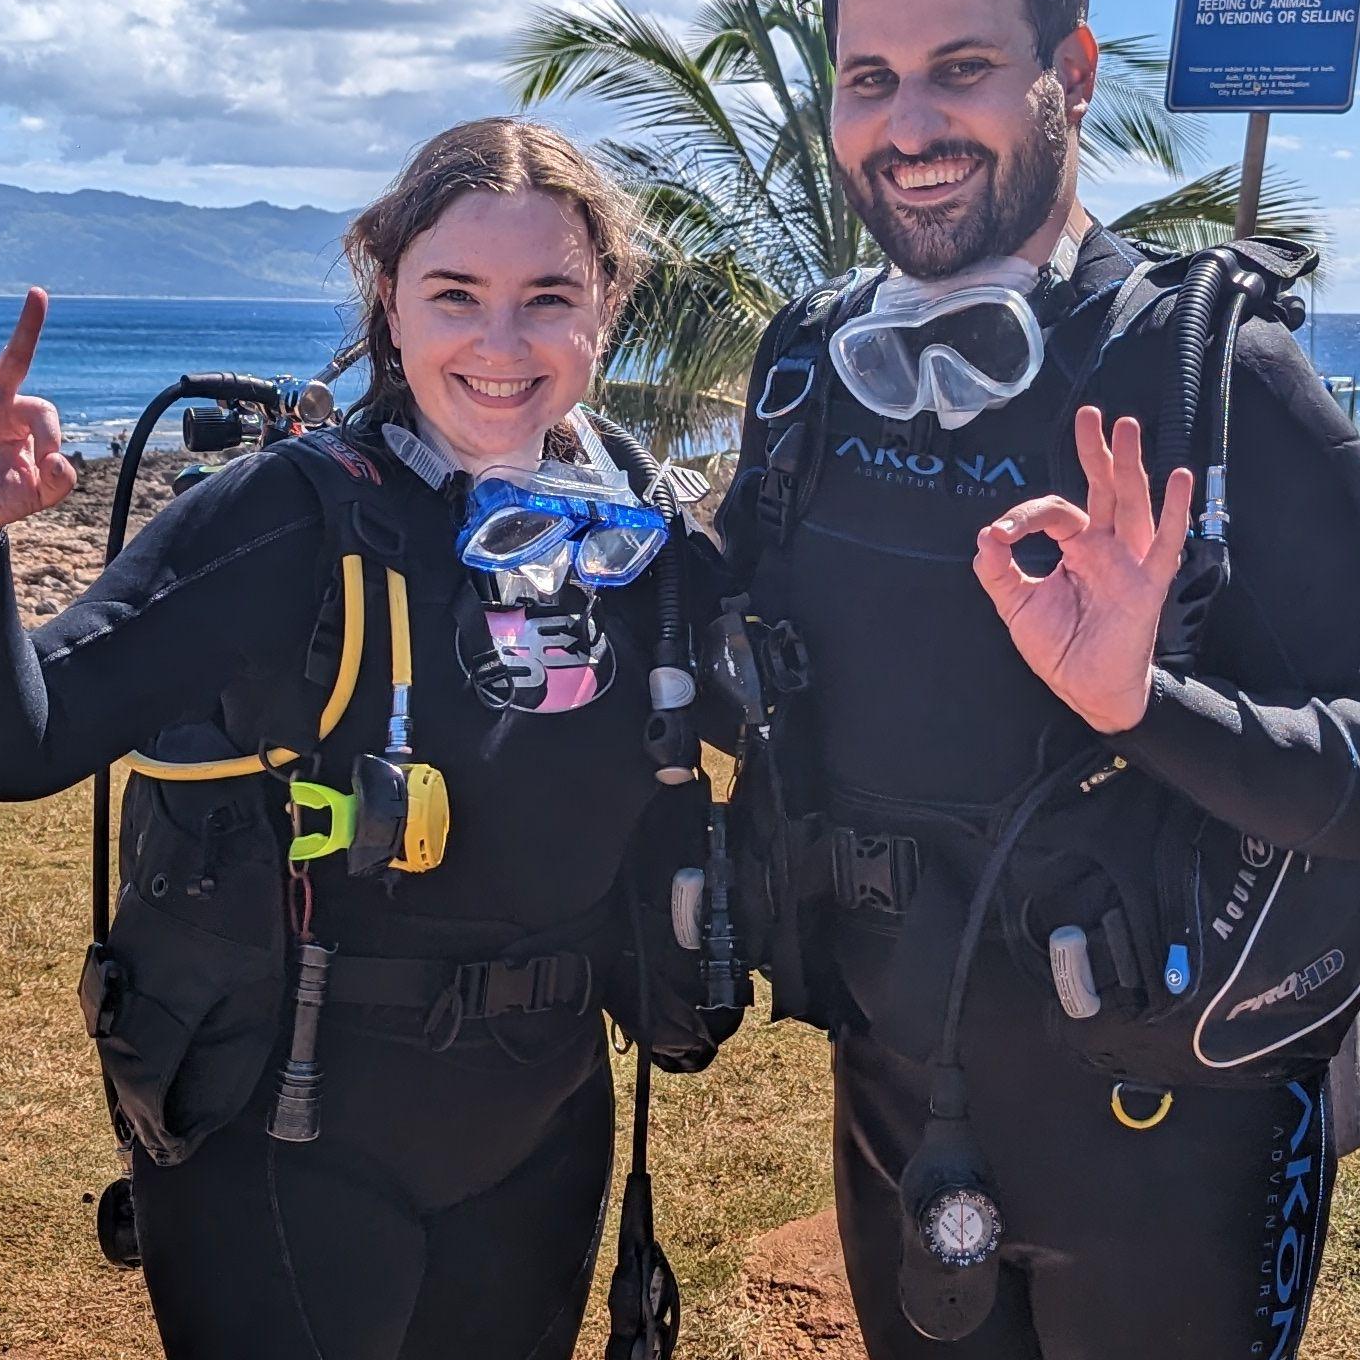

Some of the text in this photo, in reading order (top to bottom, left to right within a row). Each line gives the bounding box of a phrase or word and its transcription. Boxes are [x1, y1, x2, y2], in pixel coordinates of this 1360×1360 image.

[1196, 10, 1355, 25] NO VENDING OR SELLING
[854, 465, 937, 490] ADVENTUR
[1212, 869, 1256, 940] AQUA
[1256, 1125, 1285, 1319] ADVENTURE
